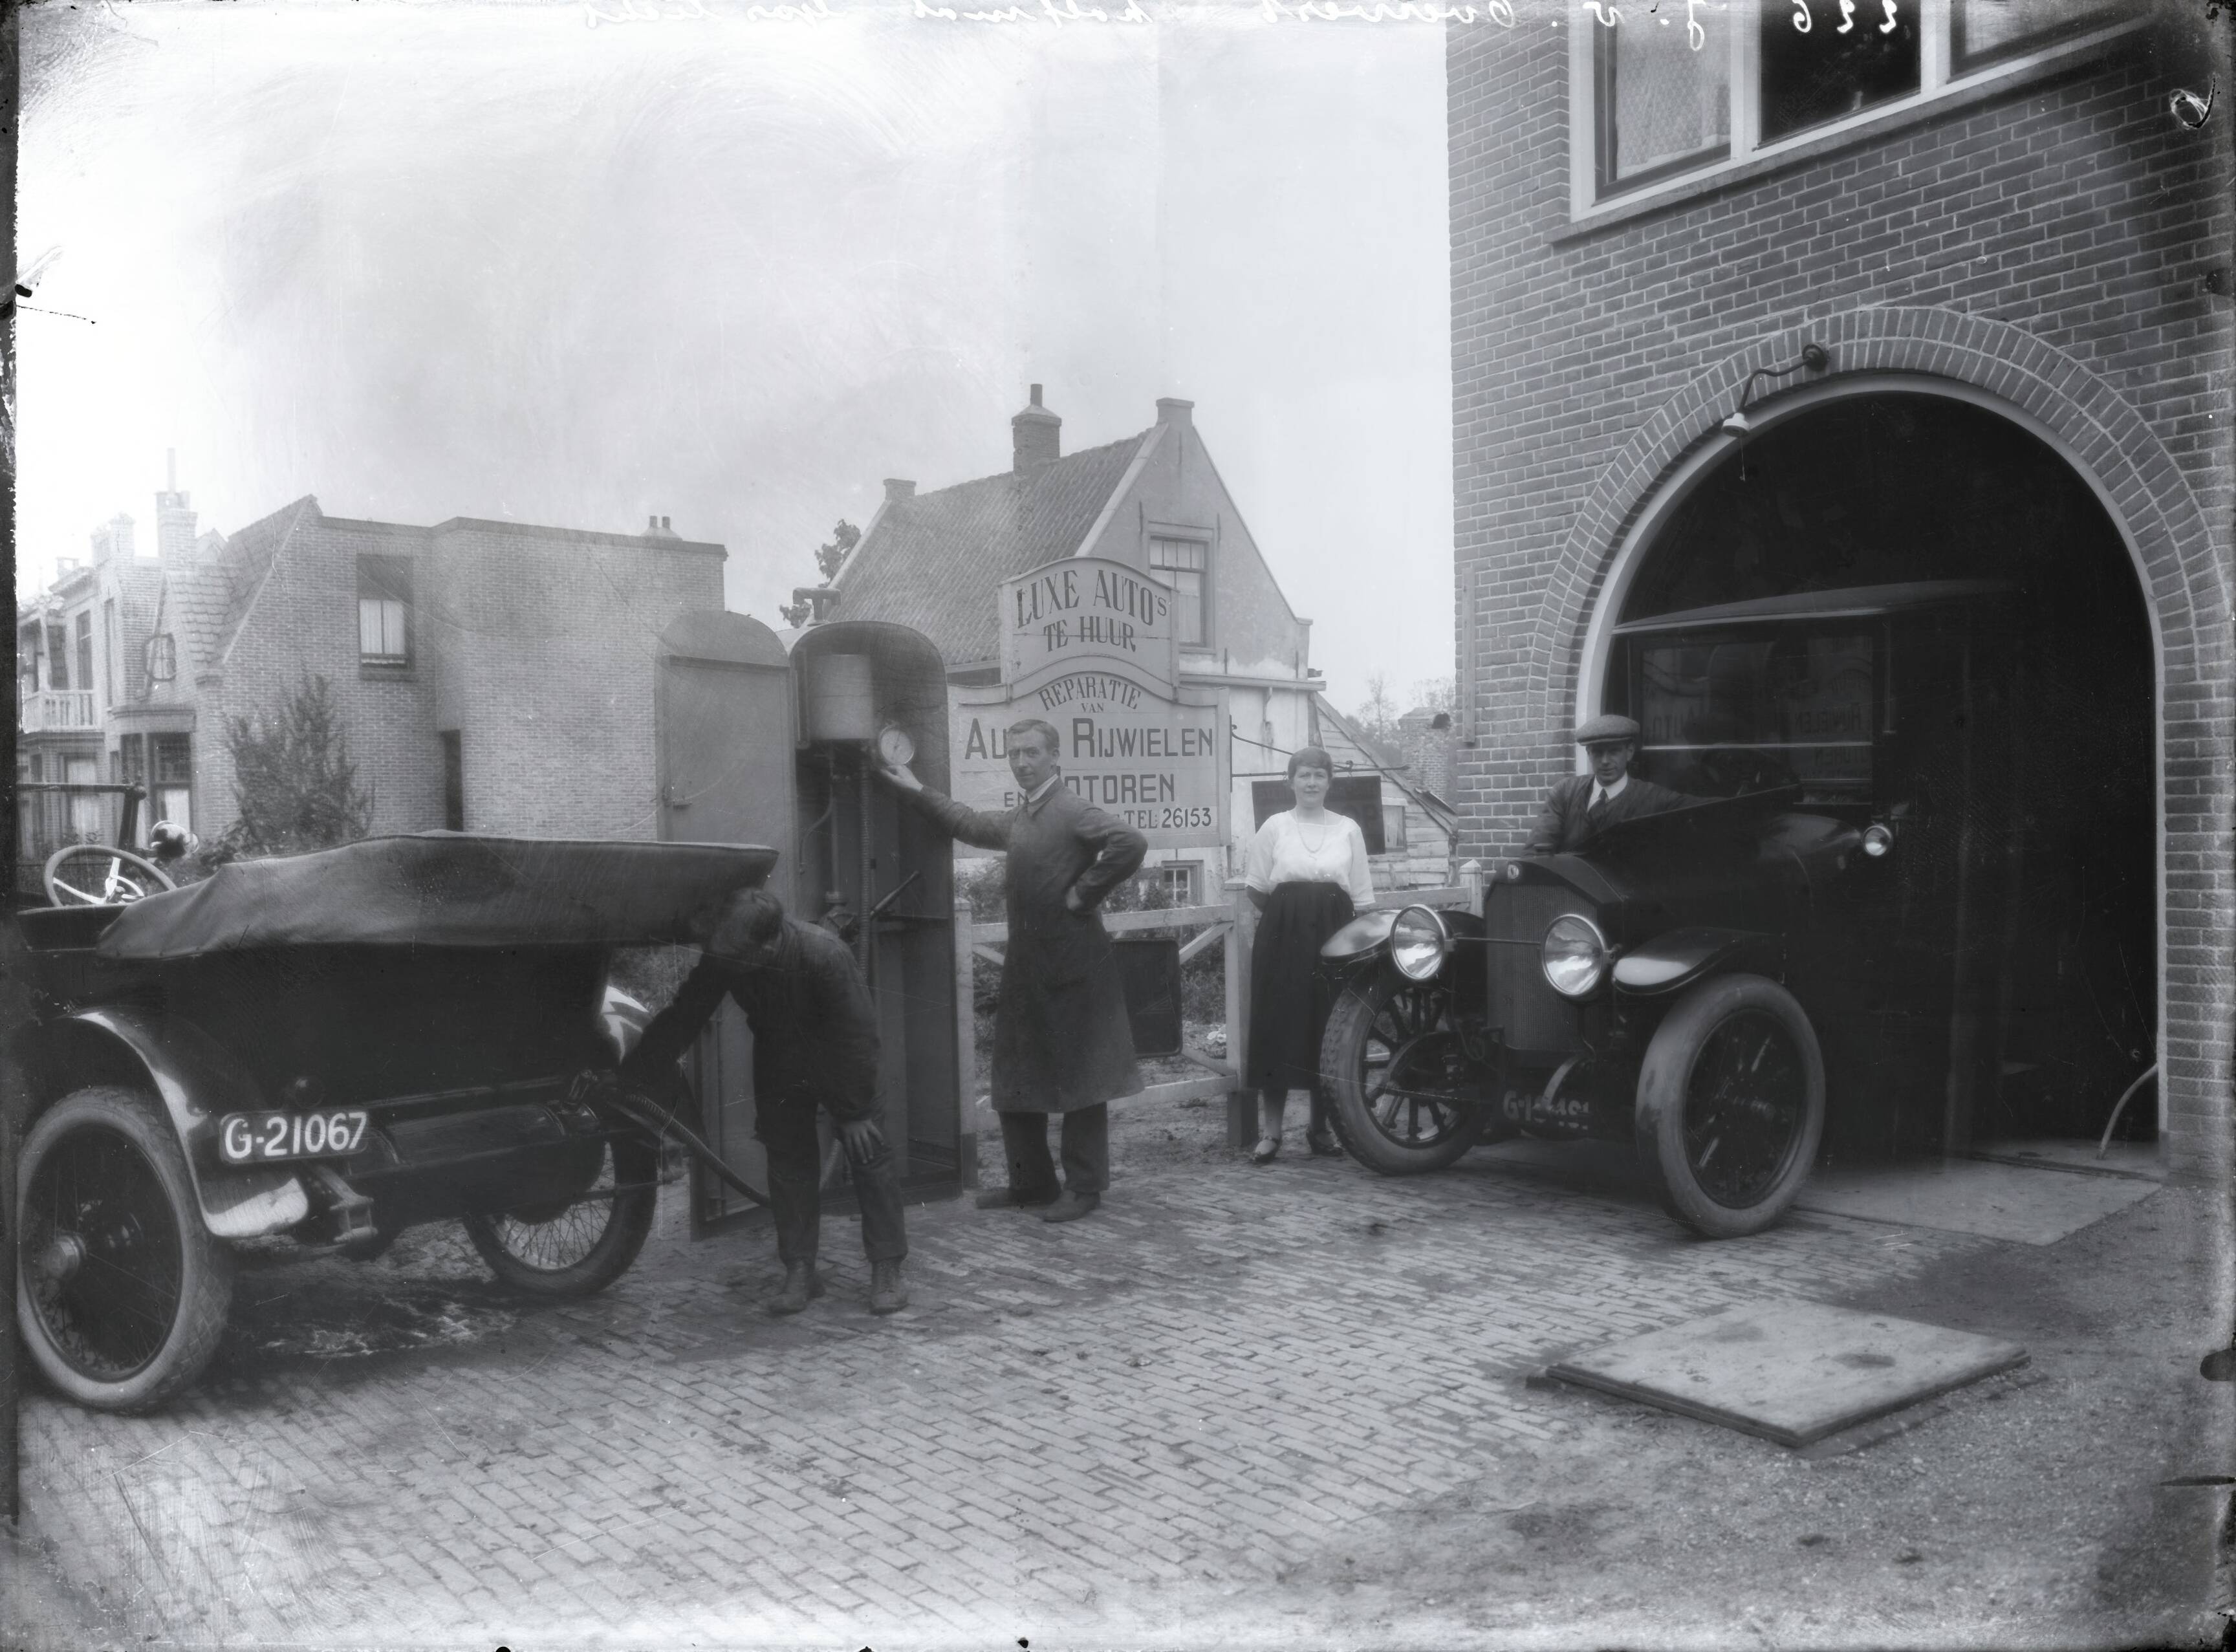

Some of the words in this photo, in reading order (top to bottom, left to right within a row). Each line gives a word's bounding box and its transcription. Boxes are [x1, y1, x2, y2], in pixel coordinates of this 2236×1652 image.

[1016, 570, 1080, 628] LUXE
[1043, 620, 1069, 652] TE
[1080, 616, 1136, 652] HUUR
[1037, 677, 1142, 711] REPARATIE
[1081, 702, 1103, 713] VAN
[965, 718, 1008, 759] AU
[1072, 717, 1213, 758] RIJWIELEN
[1056, 768, 1175, 804] OTOREN
[1162, 808, 1211, 828] 26153
[226, 1112, 367, 1158] G-21067
